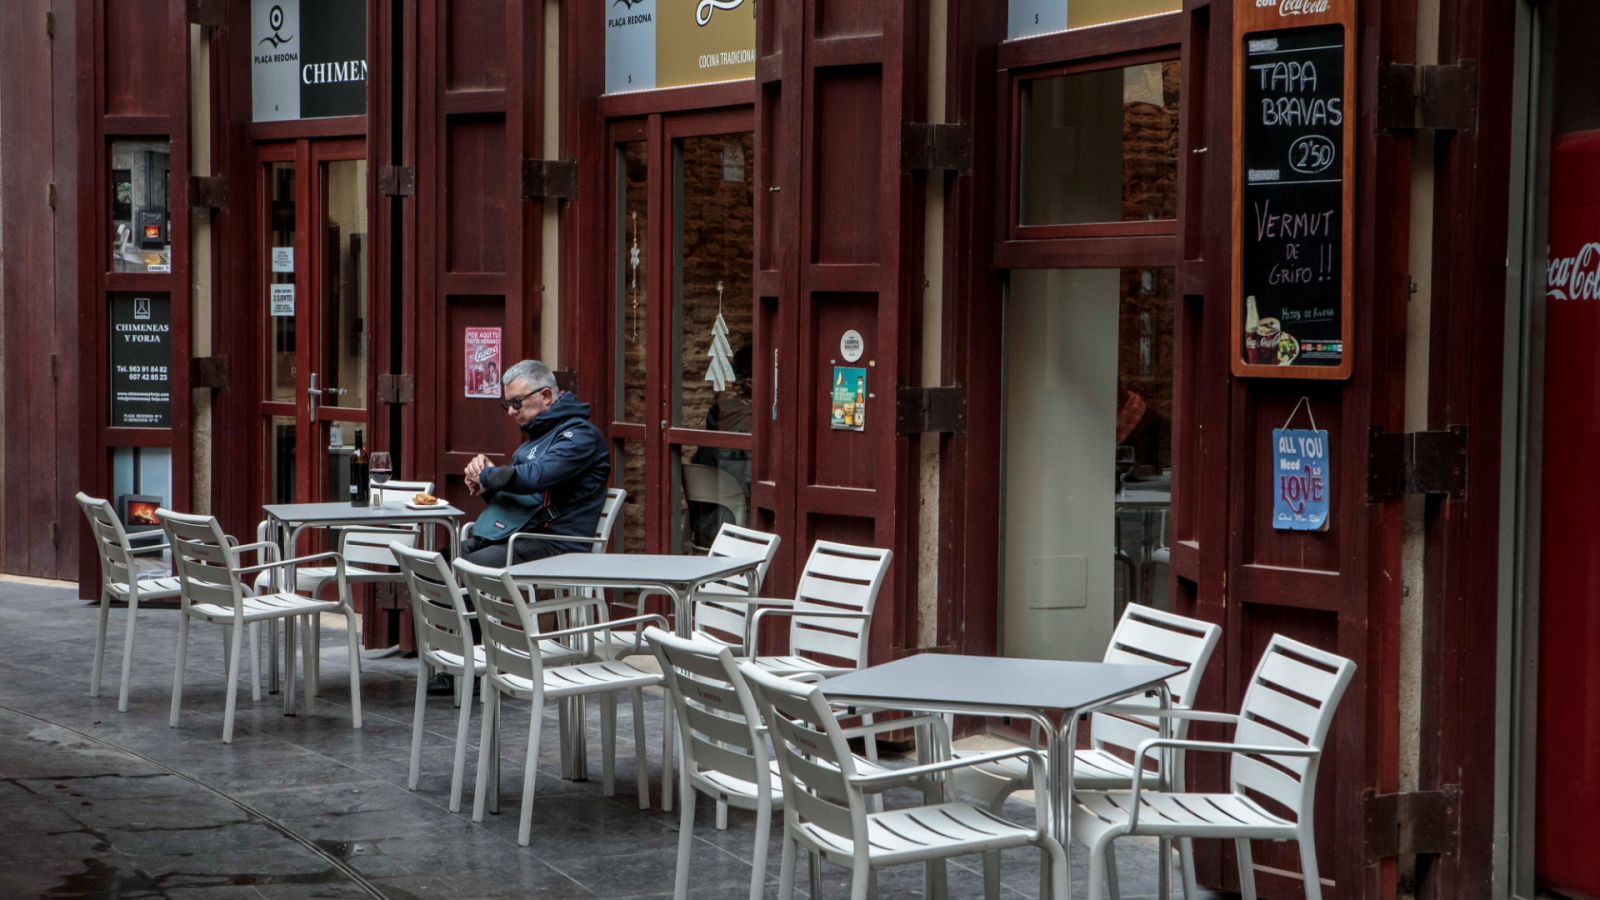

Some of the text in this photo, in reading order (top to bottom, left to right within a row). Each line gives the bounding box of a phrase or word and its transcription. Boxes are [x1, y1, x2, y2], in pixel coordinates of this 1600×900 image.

[1279, 0, 1328, 17] CocaCola
[608, 13, 652, 28] PLAÇA REDONA
[1034, 14, 1039, 24] 5
[254, 53, 298, 65] PLAÇA REDONA
[698, 54, 720, 69] COCINA
[627, 74, 632, 84] 5
[1249, 61, 1317, 93] TAPA
[1261, 96, 1342, 127] BRAVAS
[1254, 199, 1334, 242] VERMUT
[1286, 243, 1300, 260] DE
[124, 334, 161, 343] Y FORJA
[128, 373, 141, 381] 607
[141, 373, 150, 381] 42
[1279, 436, 1323, 458] ALL YOU
[1280, 458, 1300, 470] Need
[1280, 465, 1324, 513] LOVE
